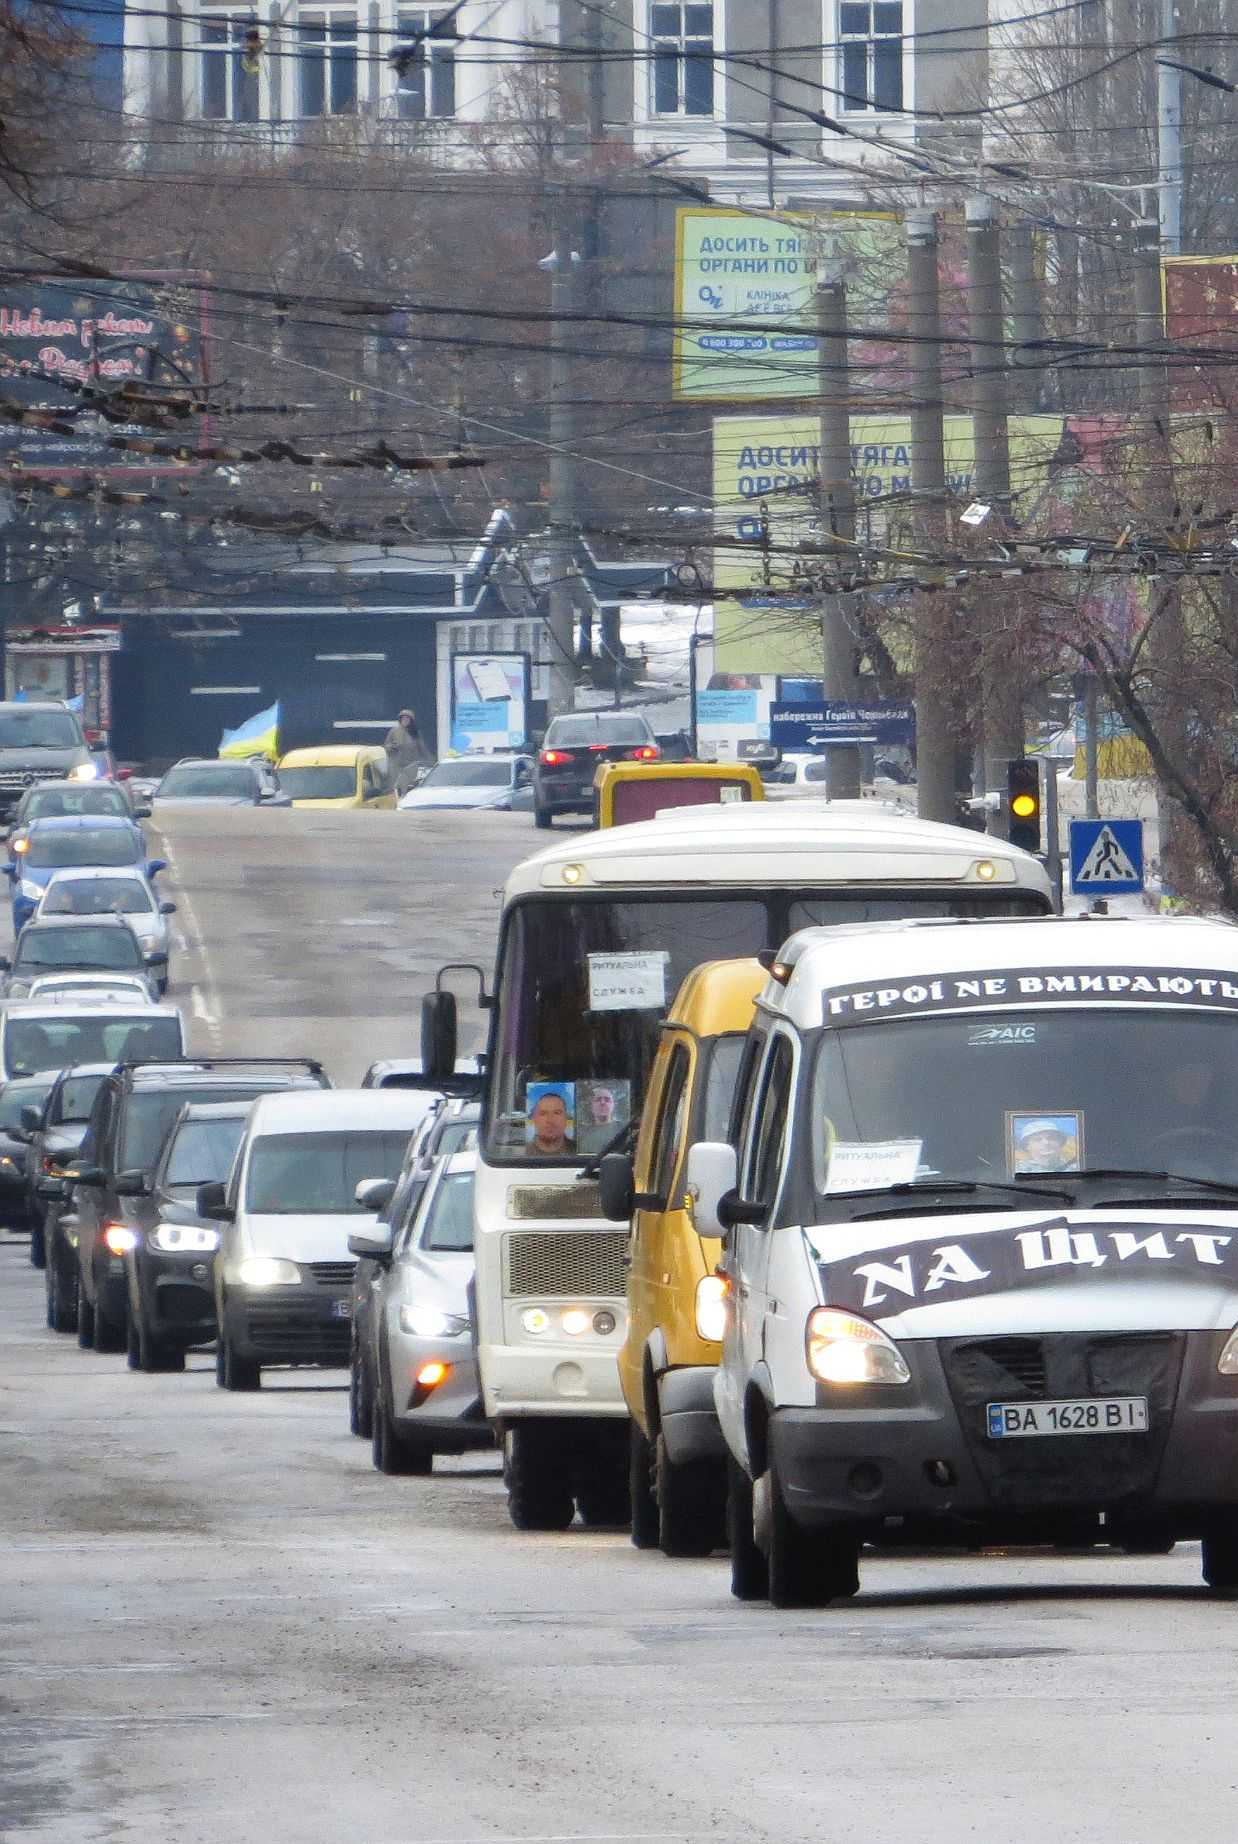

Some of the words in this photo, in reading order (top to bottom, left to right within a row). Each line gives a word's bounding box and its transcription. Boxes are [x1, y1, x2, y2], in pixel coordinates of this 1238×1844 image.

[700, 237, 769, 253] ДОСИТЬ
[700, 258, 768, 273] ОРГАНИ
[775, 259, 798, 273] ПО
[737, 446, 822, 470] ДОСИТ
[828, 980, 945, 1014] ГЕРОЇ
[1000, 1027, 1035, 1038] AIC
[1004, 1409, 1038, 1431] BA
[1047, 1405, 1099, 1429] 1628
